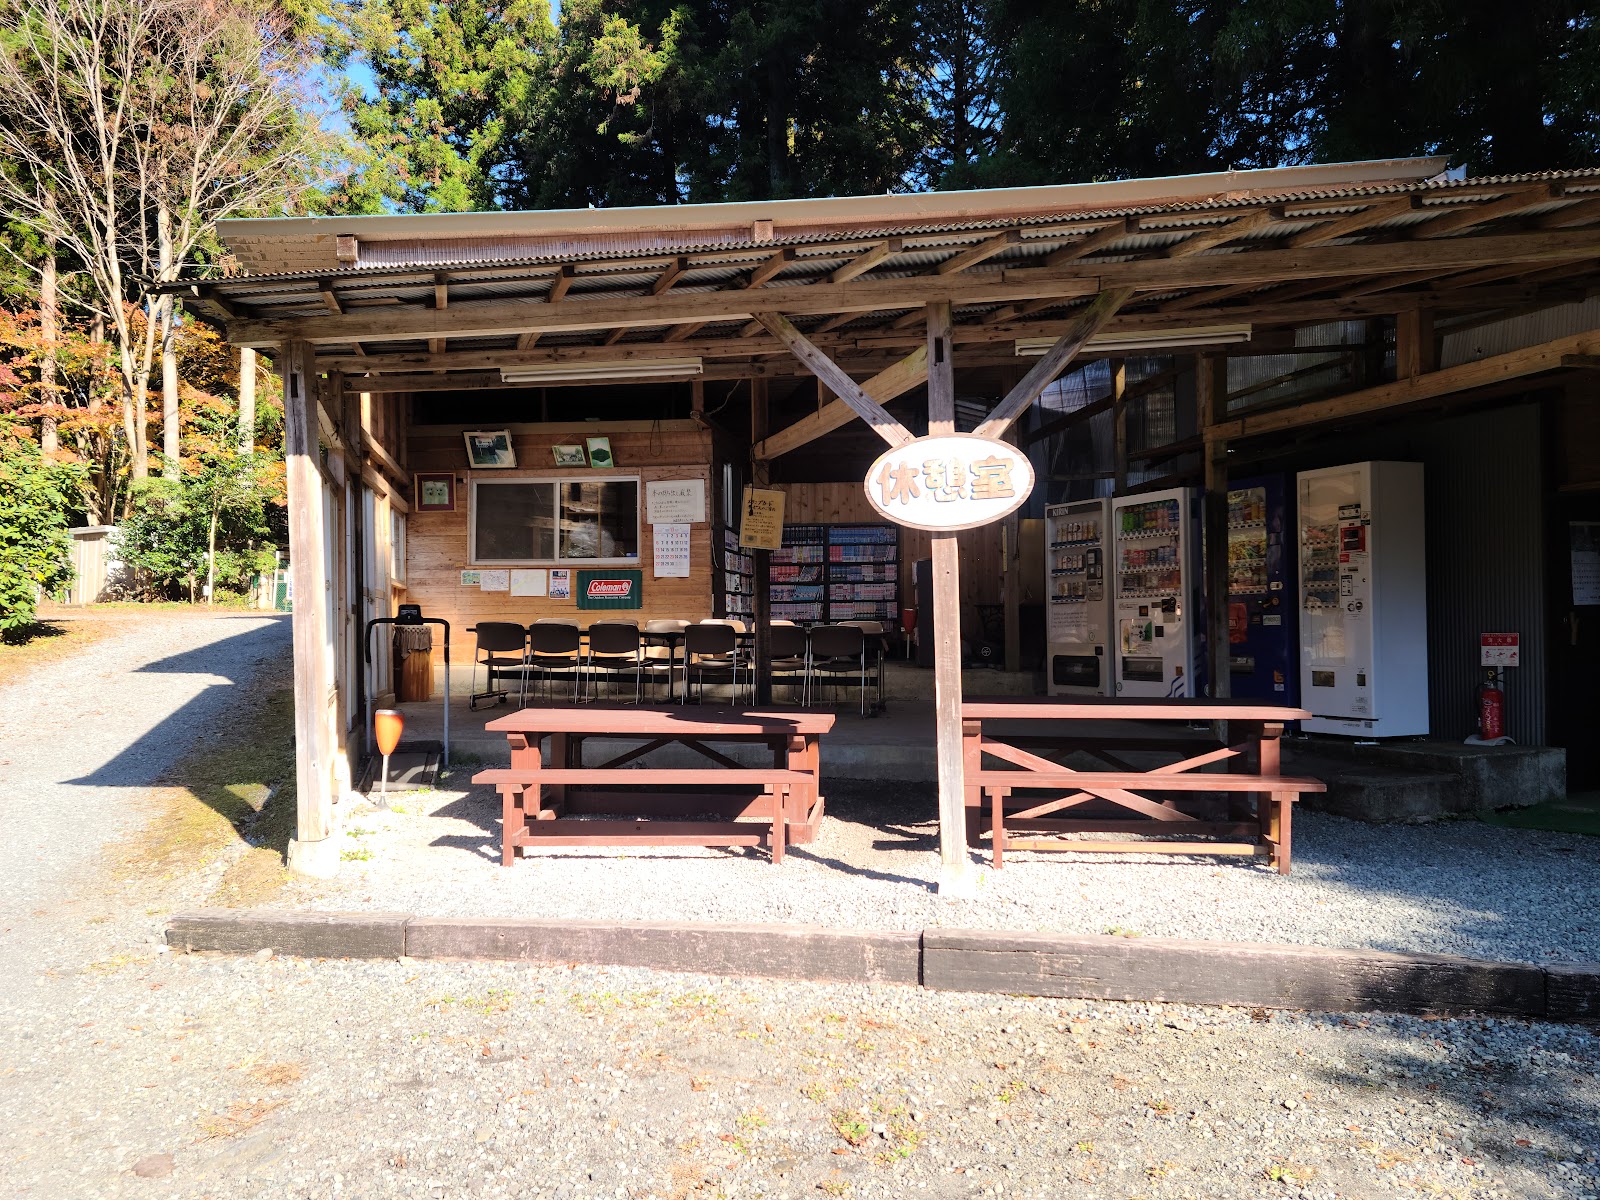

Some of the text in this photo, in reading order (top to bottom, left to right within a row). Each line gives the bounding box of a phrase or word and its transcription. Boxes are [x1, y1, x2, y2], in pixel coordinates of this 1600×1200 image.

[876, 455, 1017, 507] 休憩室
[1052, 507, 1069, 517] KIRIN
[591, 582, 622, 592] Coleman
